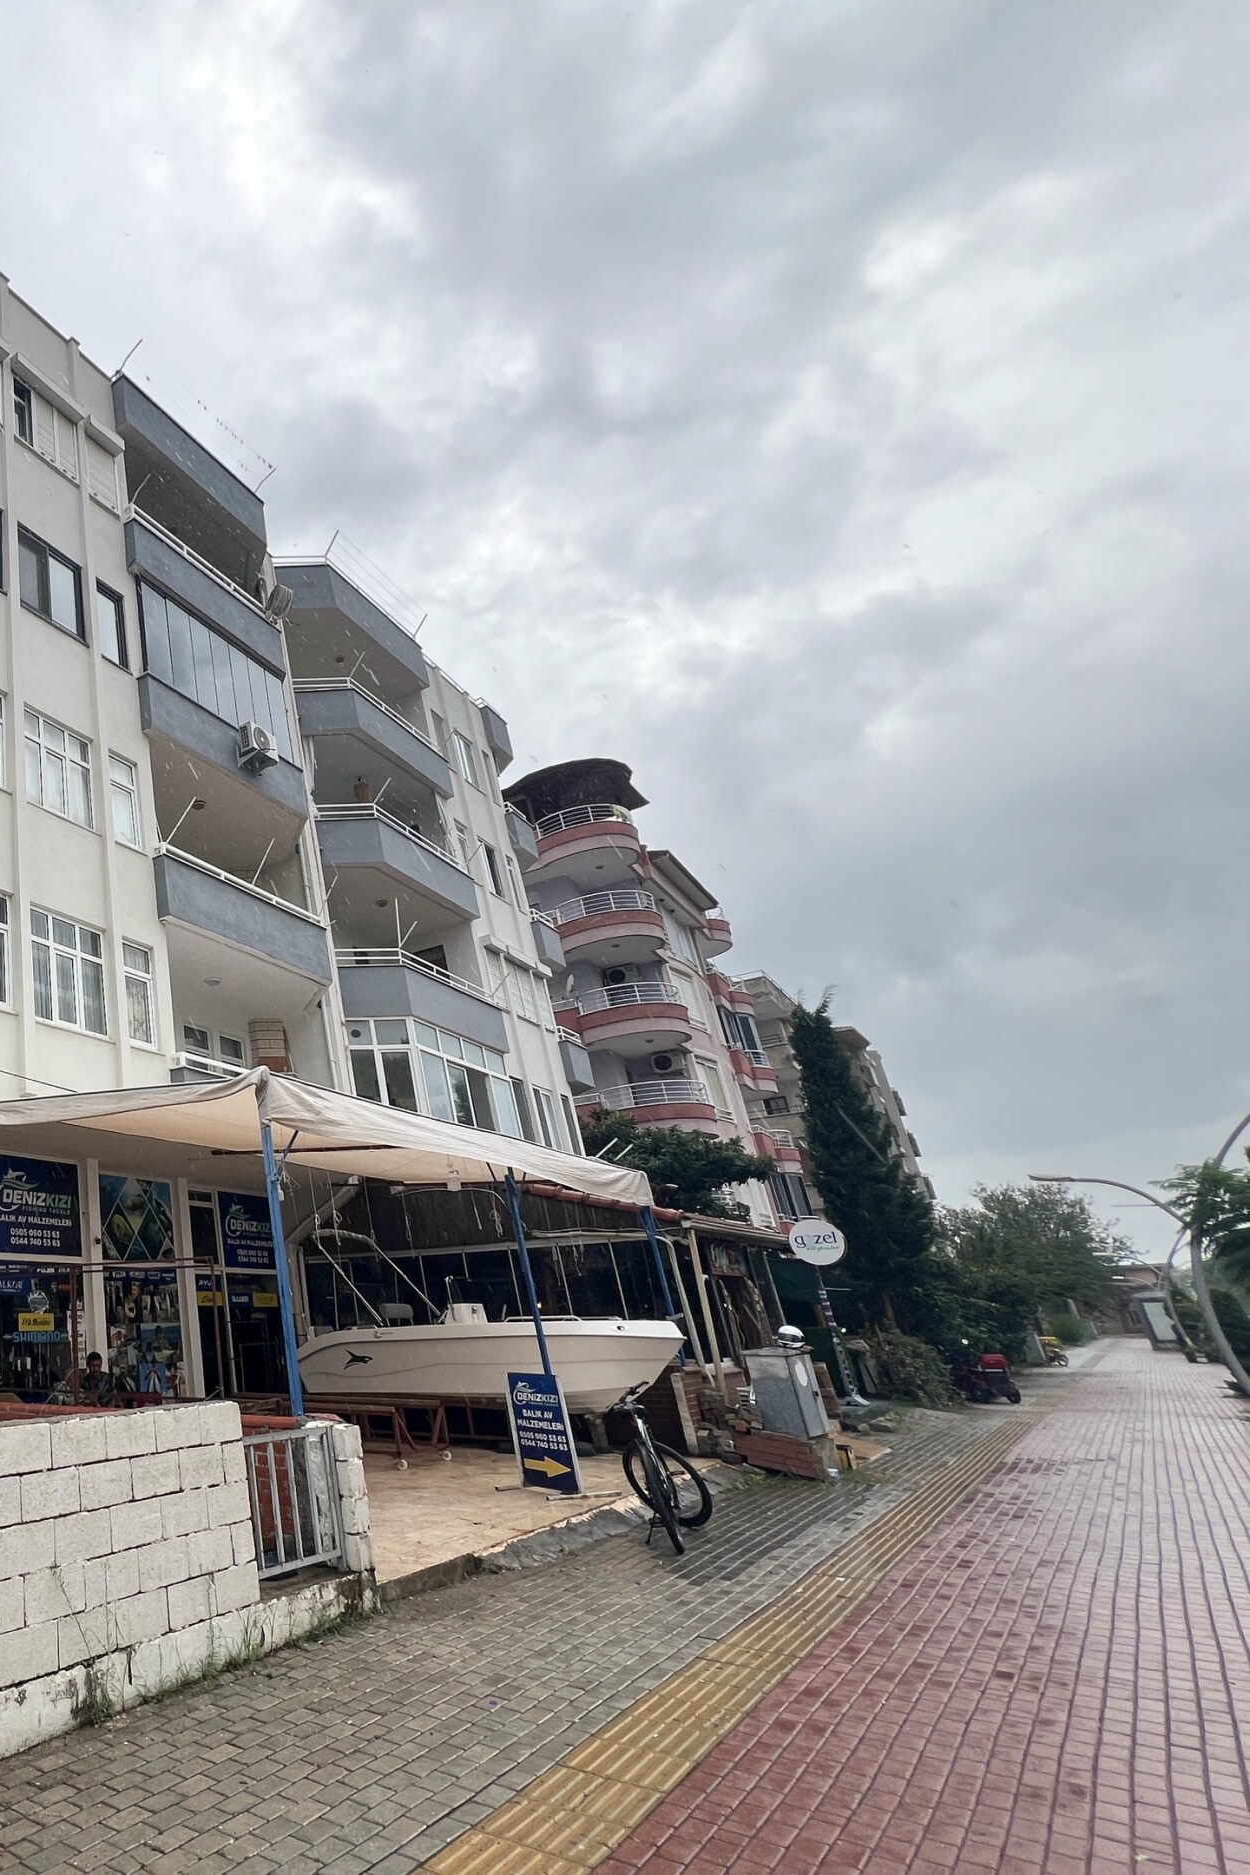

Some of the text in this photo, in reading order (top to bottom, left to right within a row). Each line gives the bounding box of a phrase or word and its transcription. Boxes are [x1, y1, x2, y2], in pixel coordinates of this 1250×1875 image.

[17, 1215, 27, 1223] AV
[230, 1219, 271, 1233] DENİZKIZ
[10, 1228, 28, 1236] 0505
[43, 1230, 51, 1238] 53
[52, 1230, 60, 1239] 63
[10, 1236, 61, 1247] 0544 740 53 63
[794, 1231, 837, 1249] gzel
[522, 1409, 553, 1419] BALIK AV
[519, 1431, 534, 1439] 0505
[548, 1434, 557, 1442] 53
[557, 1435, 567, 1443] 63
[520, 1438, 536, 1447] 0544
[549, 1442, 558, 1450] 53
